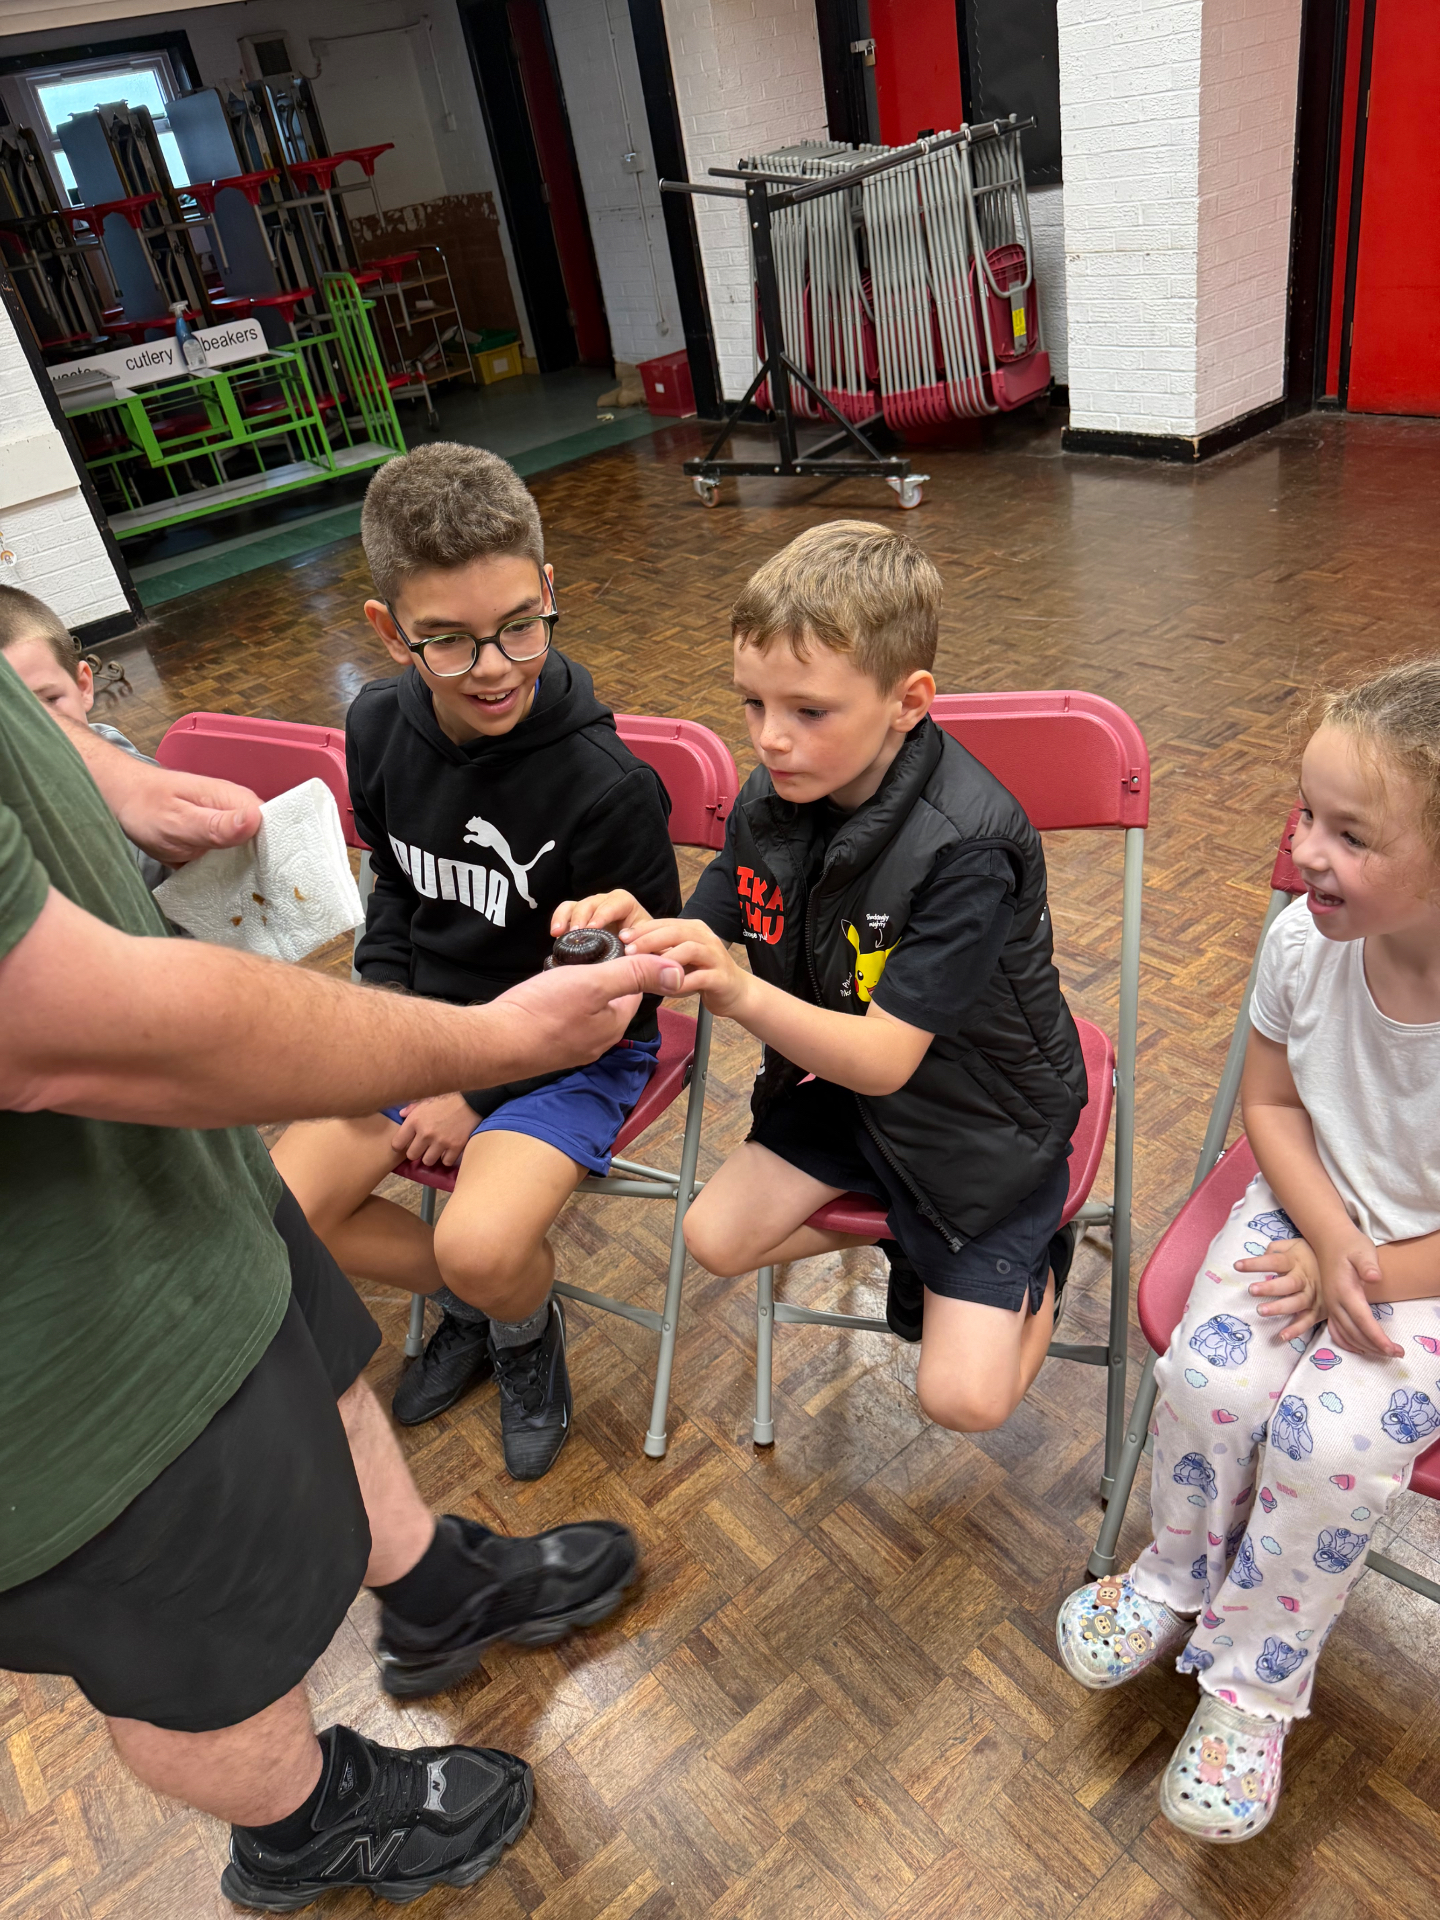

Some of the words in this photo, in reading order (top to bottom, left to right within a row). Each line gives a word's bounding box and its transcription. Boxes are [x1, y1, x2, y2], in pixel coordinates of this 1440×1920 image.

[125, 347, 173, 371] cutlery
[201, 326, 258, 352] beakers
[388, 832, 509, 927] PUMA
[739, 901, 785, 945] HU
